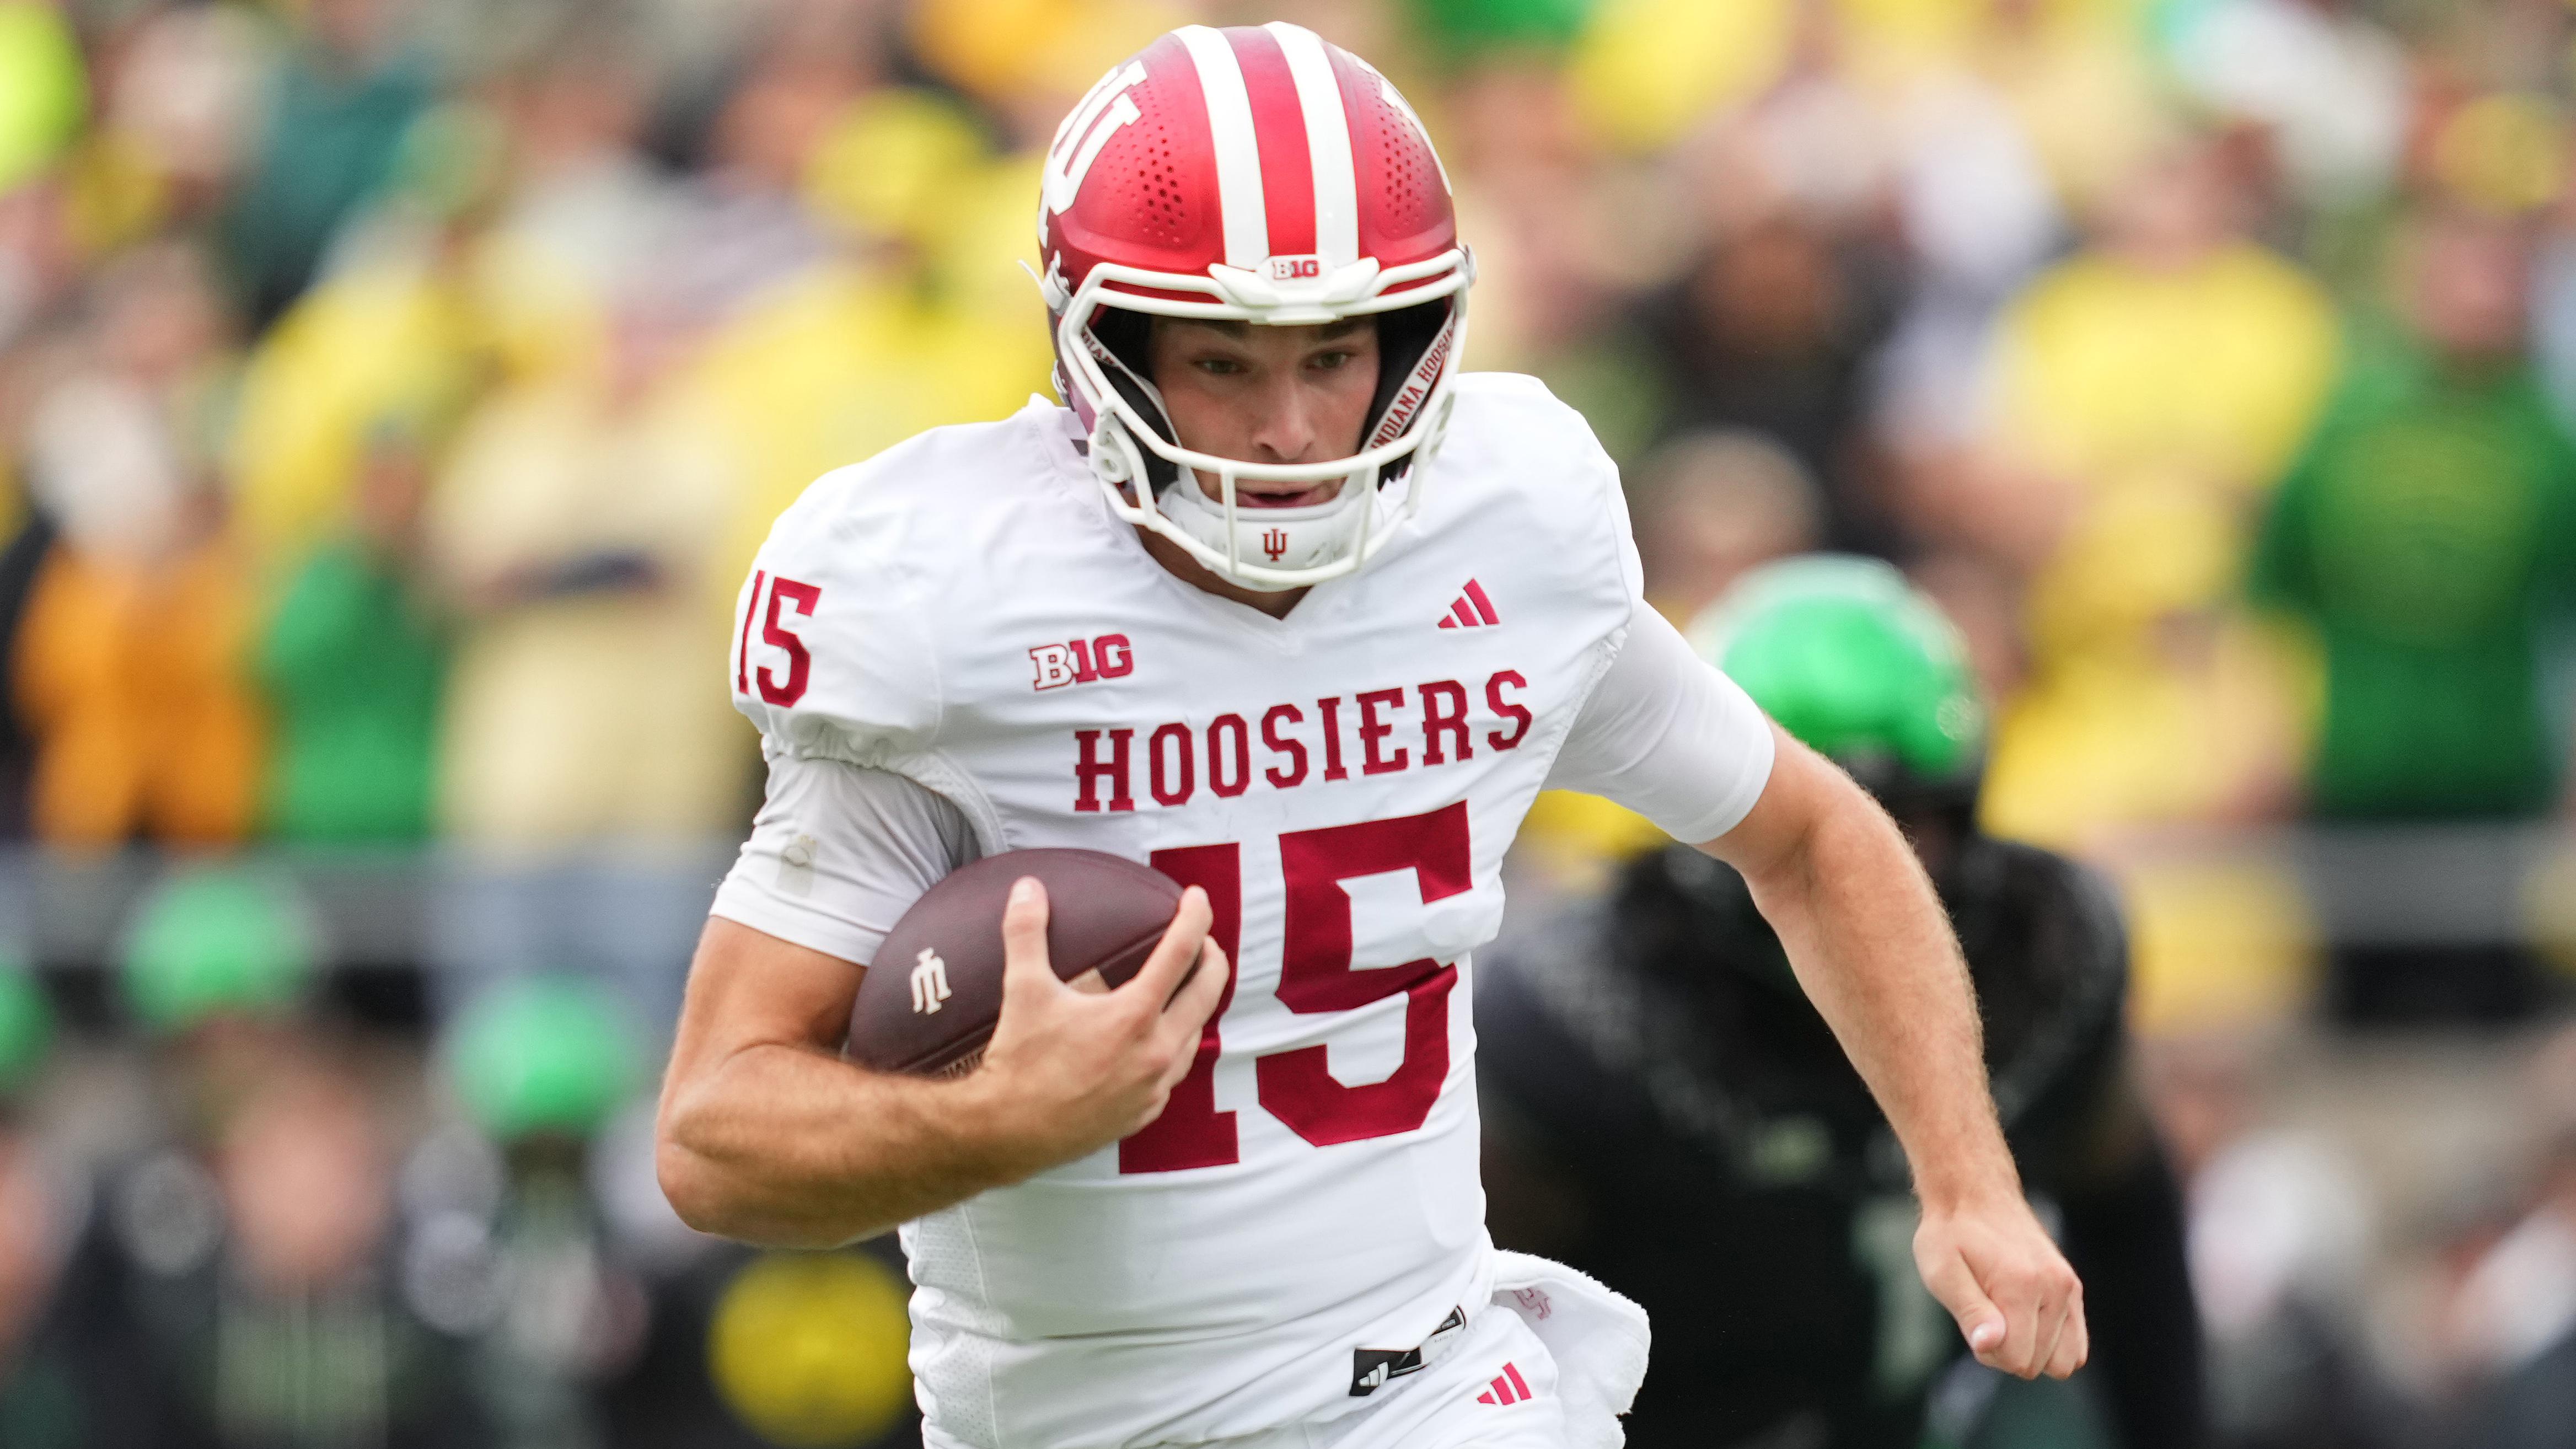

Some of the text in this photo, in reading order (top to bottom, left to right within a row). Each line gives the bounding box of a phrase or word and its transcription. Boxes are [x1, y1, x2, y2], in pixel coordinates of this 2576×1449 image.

[738, 570, 822, 708] 15
[1074, 669, 1533, 812] HOOSIERS
[1119, 799, 1473, 1174] 15
